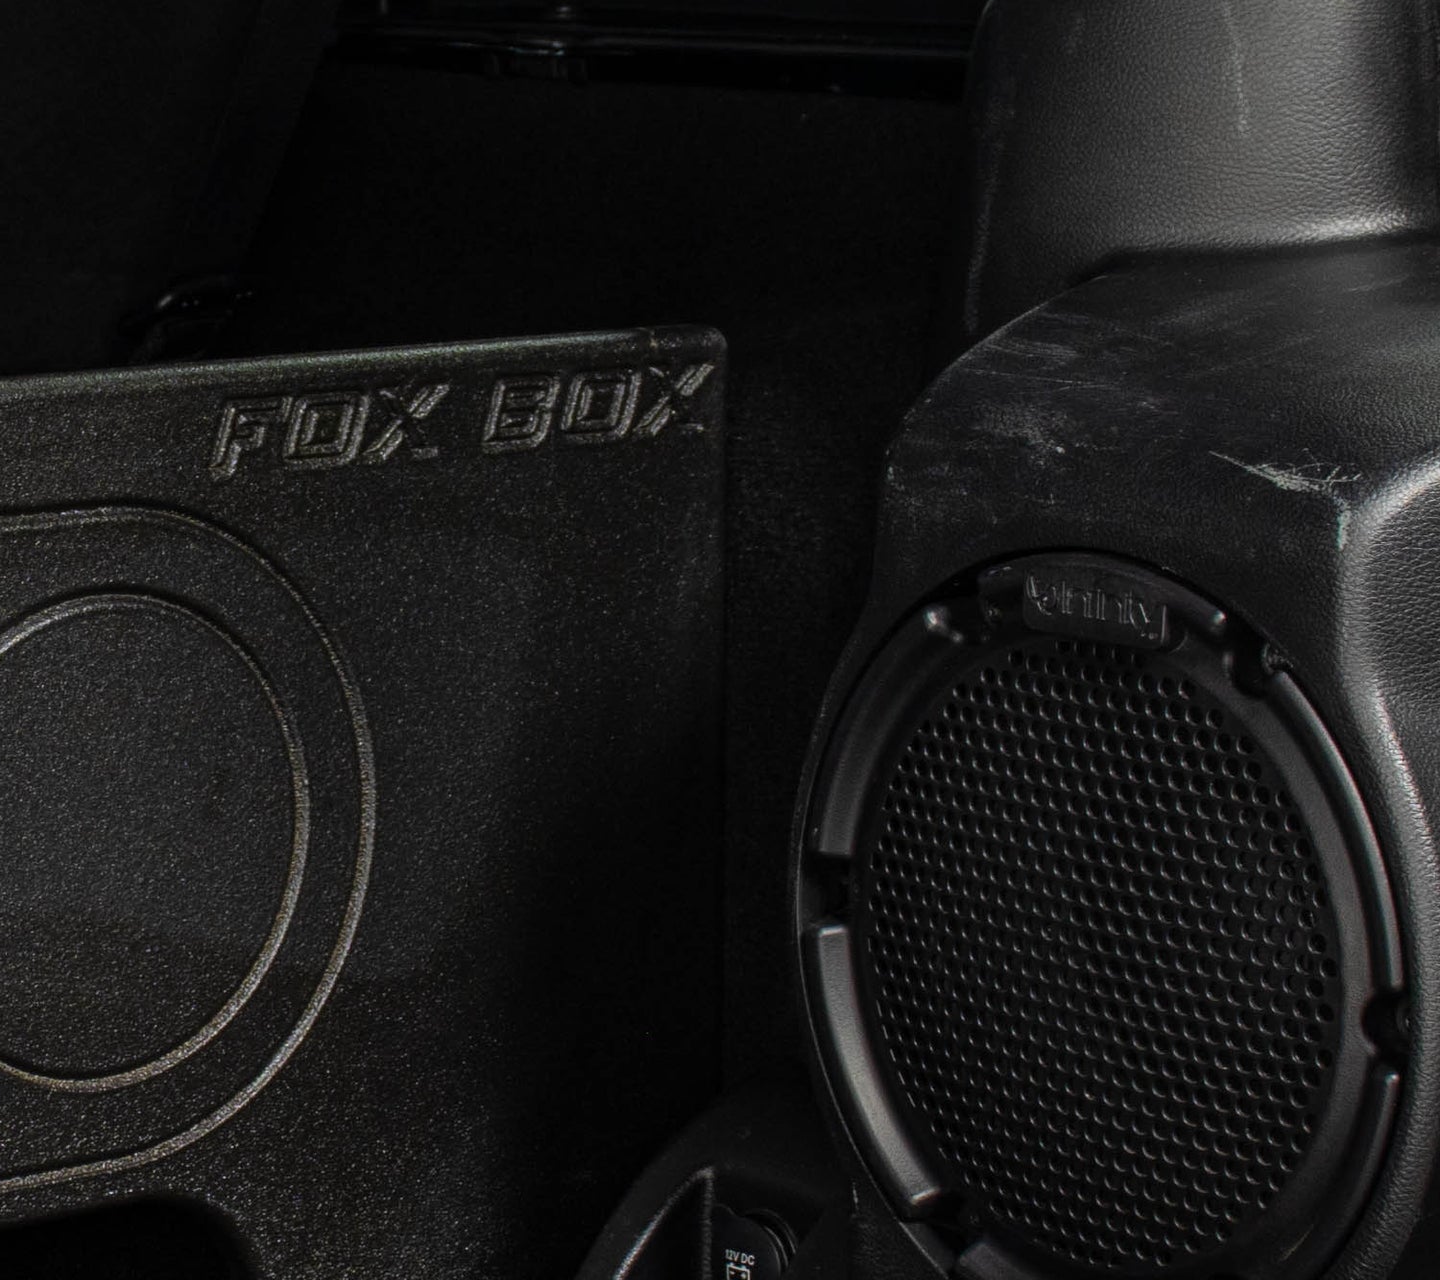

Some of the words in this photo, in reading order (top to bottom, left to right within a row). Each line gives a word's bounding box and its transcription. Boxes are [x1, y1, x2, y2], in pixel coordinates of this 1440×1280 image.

[210, 381, 452, 482] FOX
[481, 362, 717, 454] BOX
[740, 1253, 756, 1266] DC
